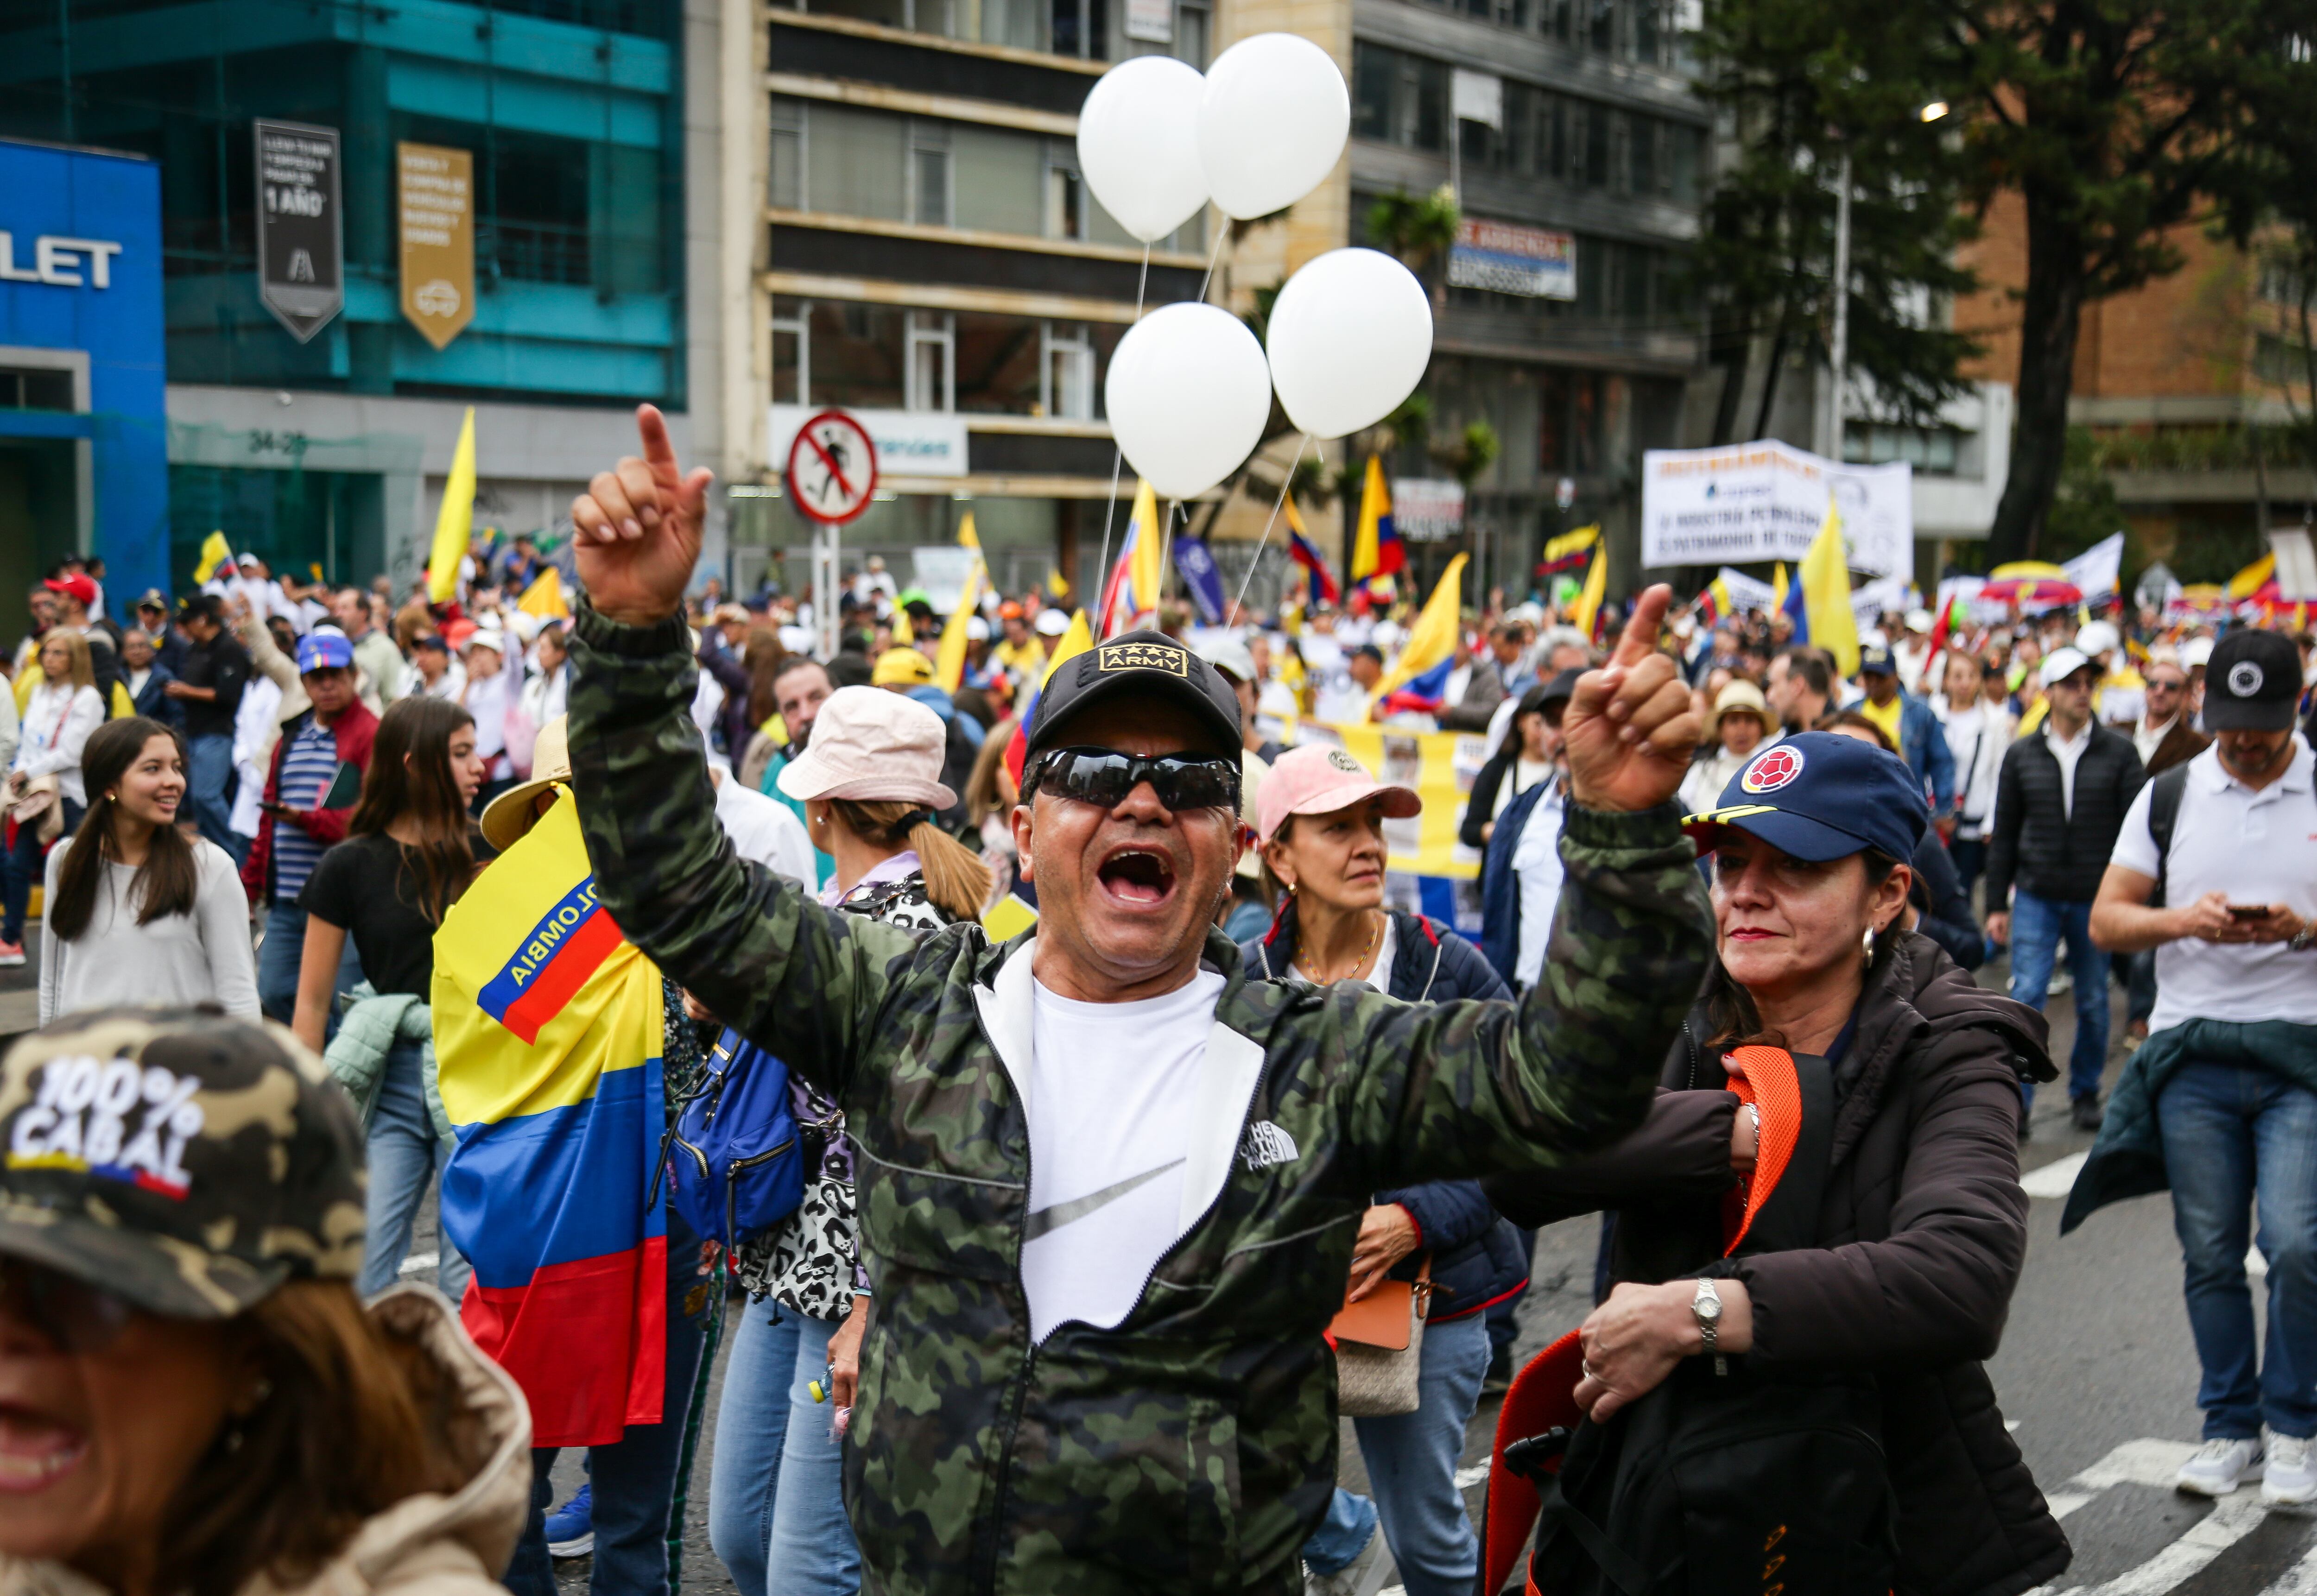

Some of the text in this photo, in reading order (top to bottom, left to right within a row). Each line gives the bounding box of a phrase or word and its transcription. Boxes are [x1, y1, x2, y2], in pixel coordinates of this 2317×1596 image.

[266, 186, 277, 213] 1
[1107, 656, 1180, 669] ARMY
[36, 1055, 205, 1139] 100%
[11, 1105, 193, 1188] CABAL
